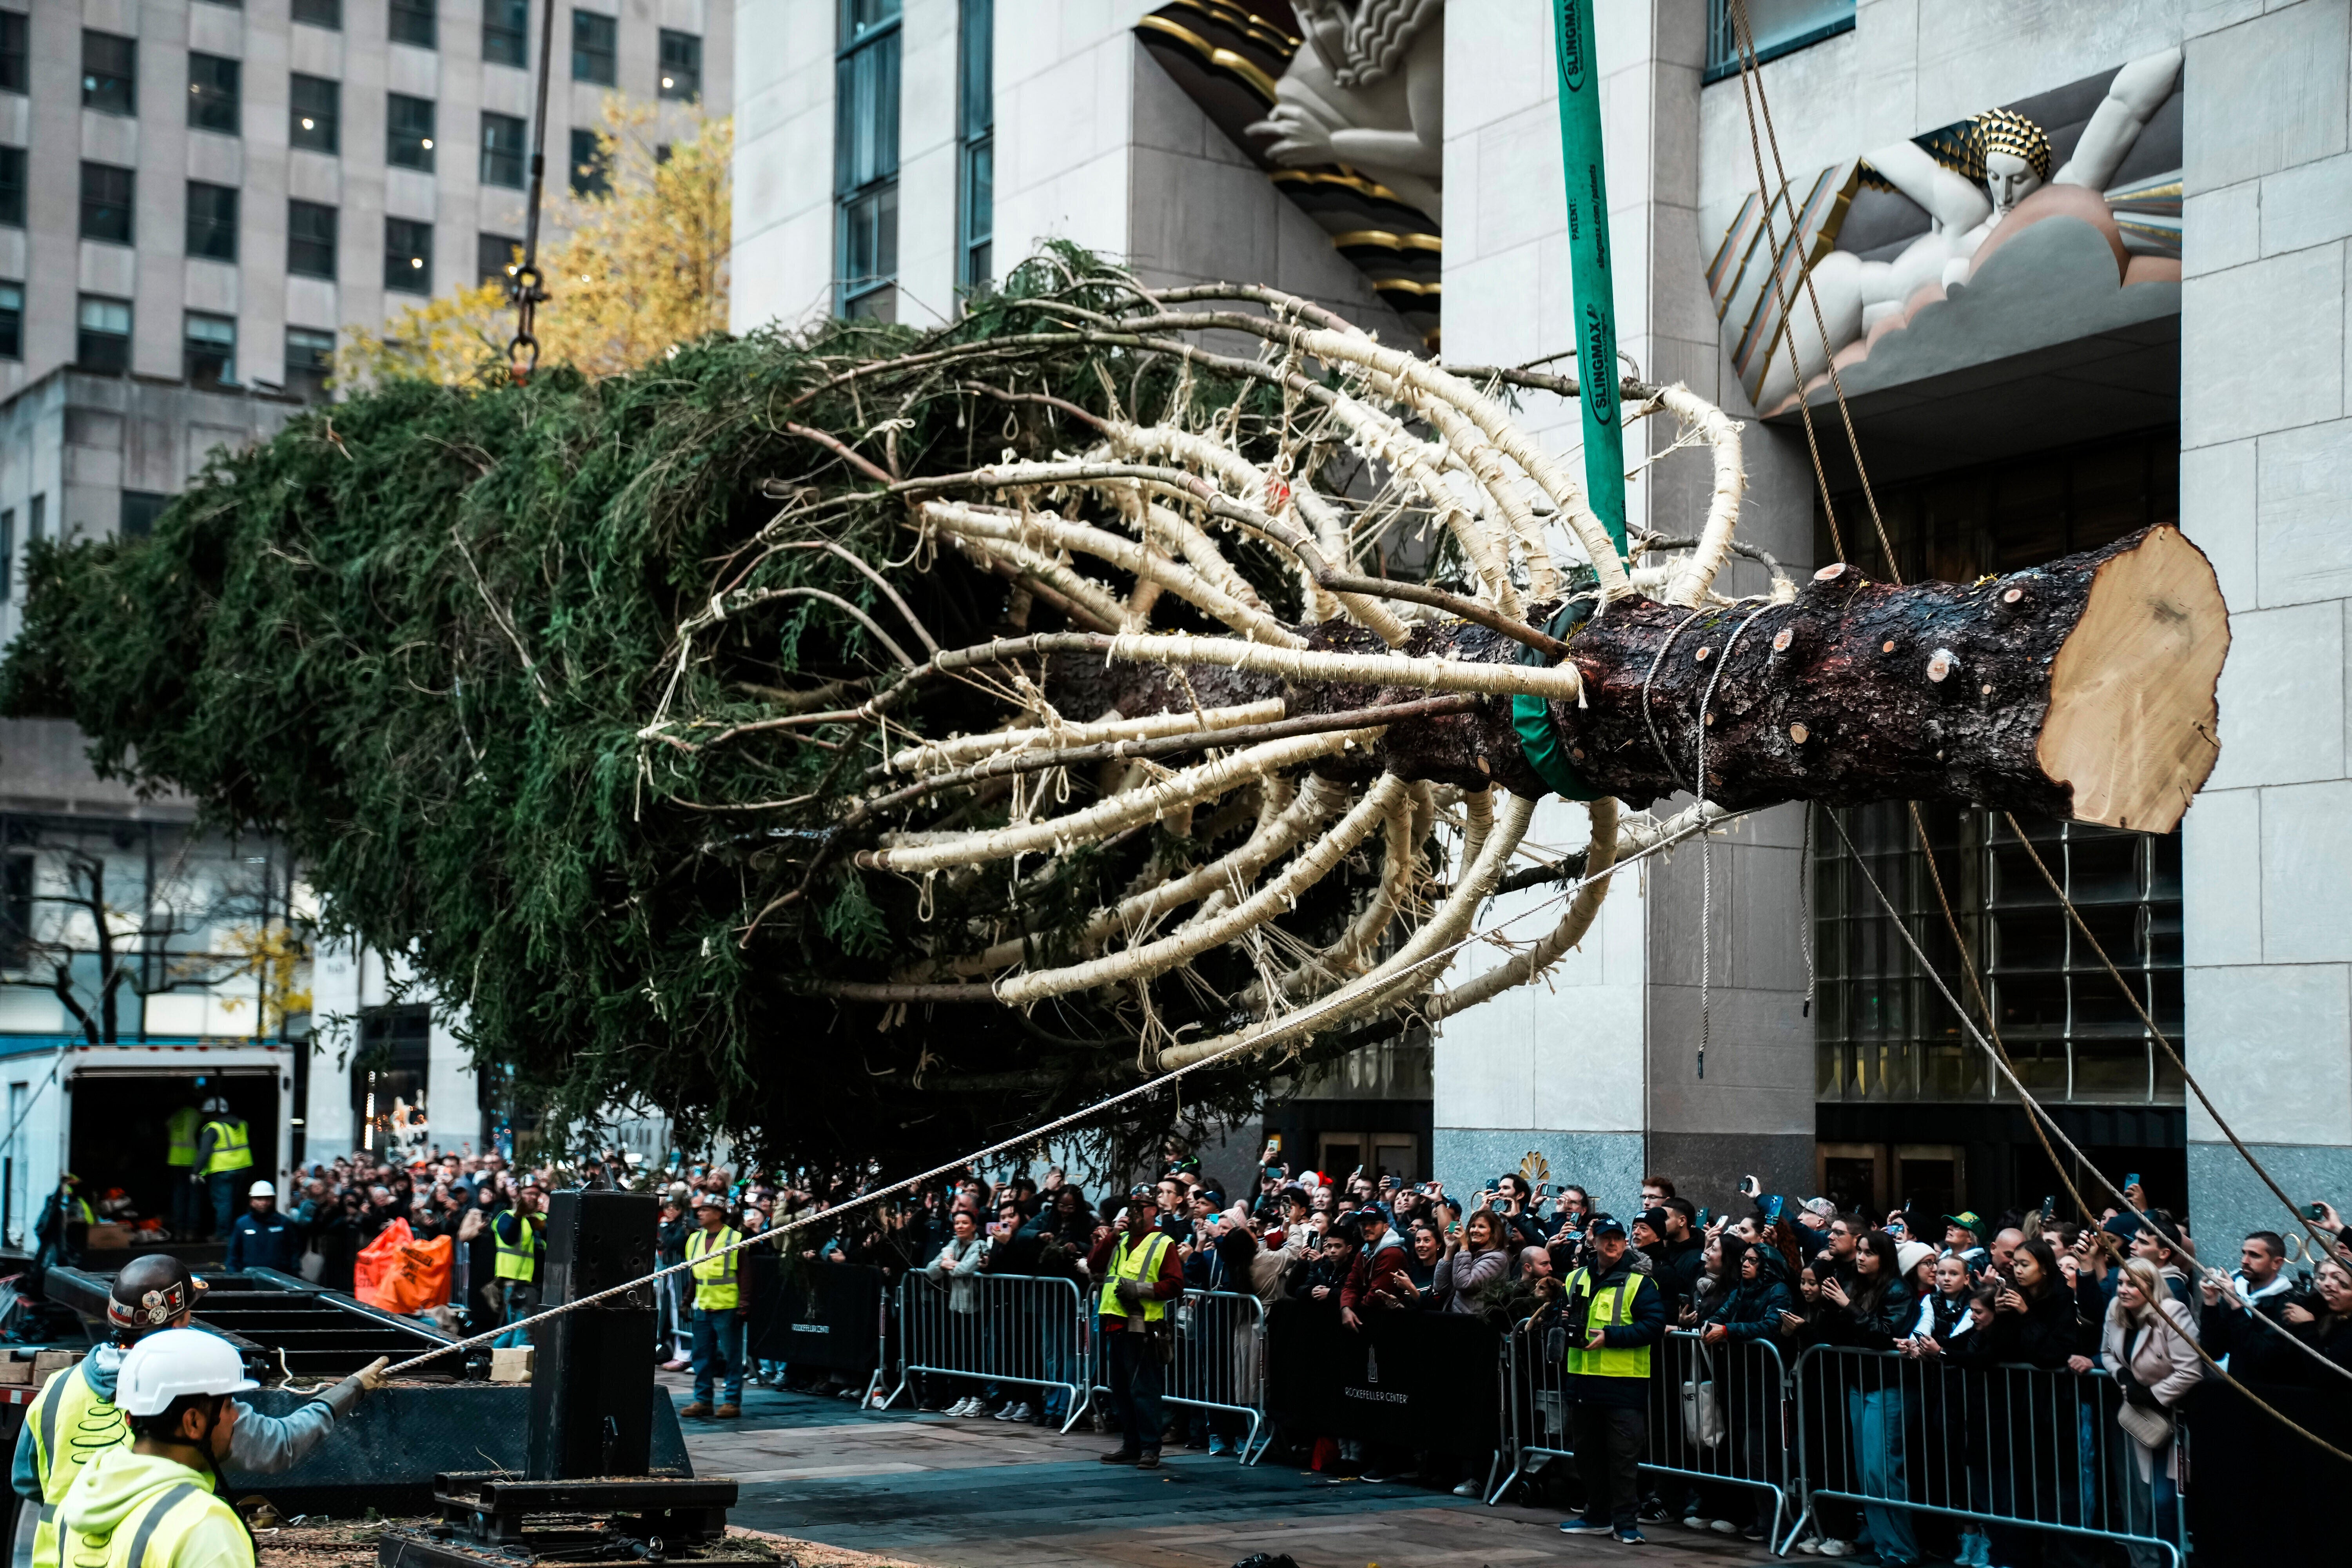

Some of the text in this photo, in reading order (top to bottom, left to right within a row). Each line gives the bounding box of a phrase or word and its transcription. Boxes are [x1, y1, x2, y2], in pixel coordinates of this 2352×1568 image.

[1569, 198, 1579, 241] PATENT:
[1589, 164, 1605, 269] slingmax.com/patents
[1345, 1387, 1408, 1404] ROCKEFELLER CENTER
